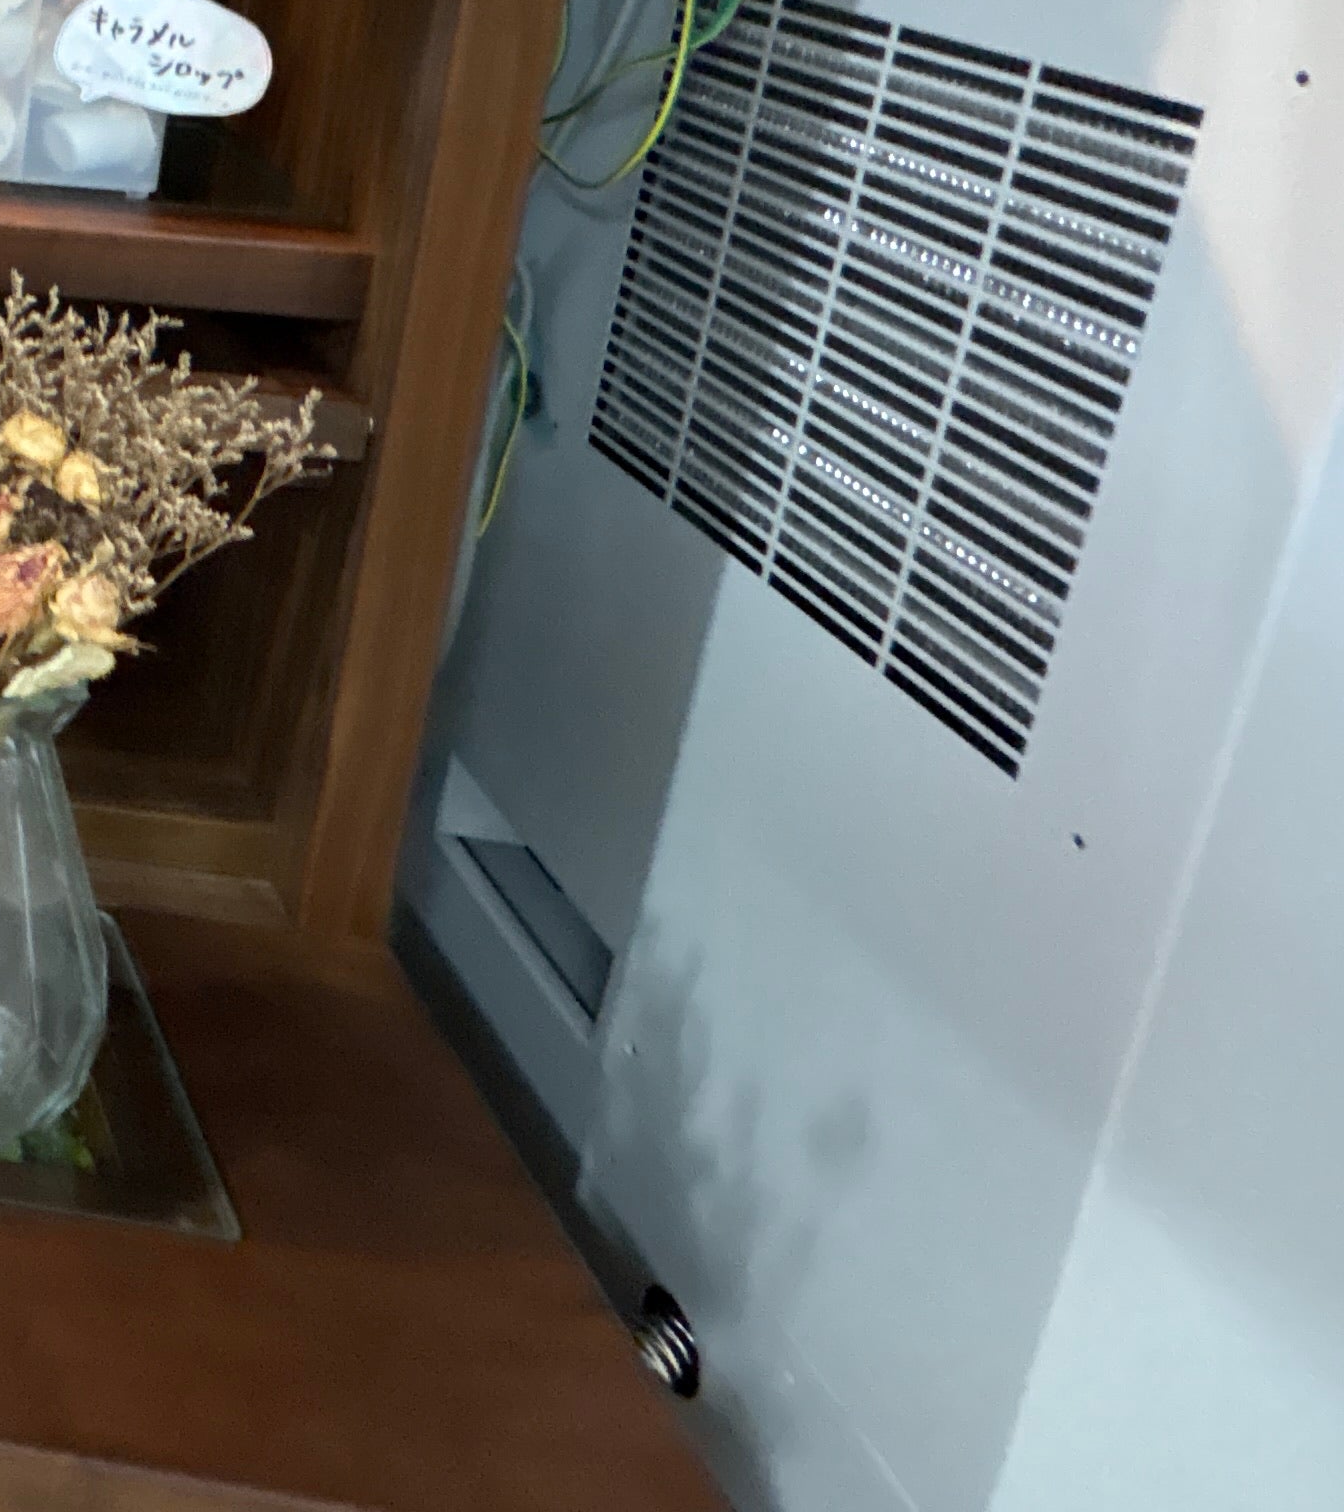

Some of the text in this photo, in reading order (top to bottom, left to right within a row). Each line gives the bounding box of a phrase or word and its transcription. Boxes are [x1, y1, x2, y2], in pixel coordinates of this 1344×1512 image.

[89, 5, 196, 50] キャラメル
[148, 51, 246, 91] シロップ
